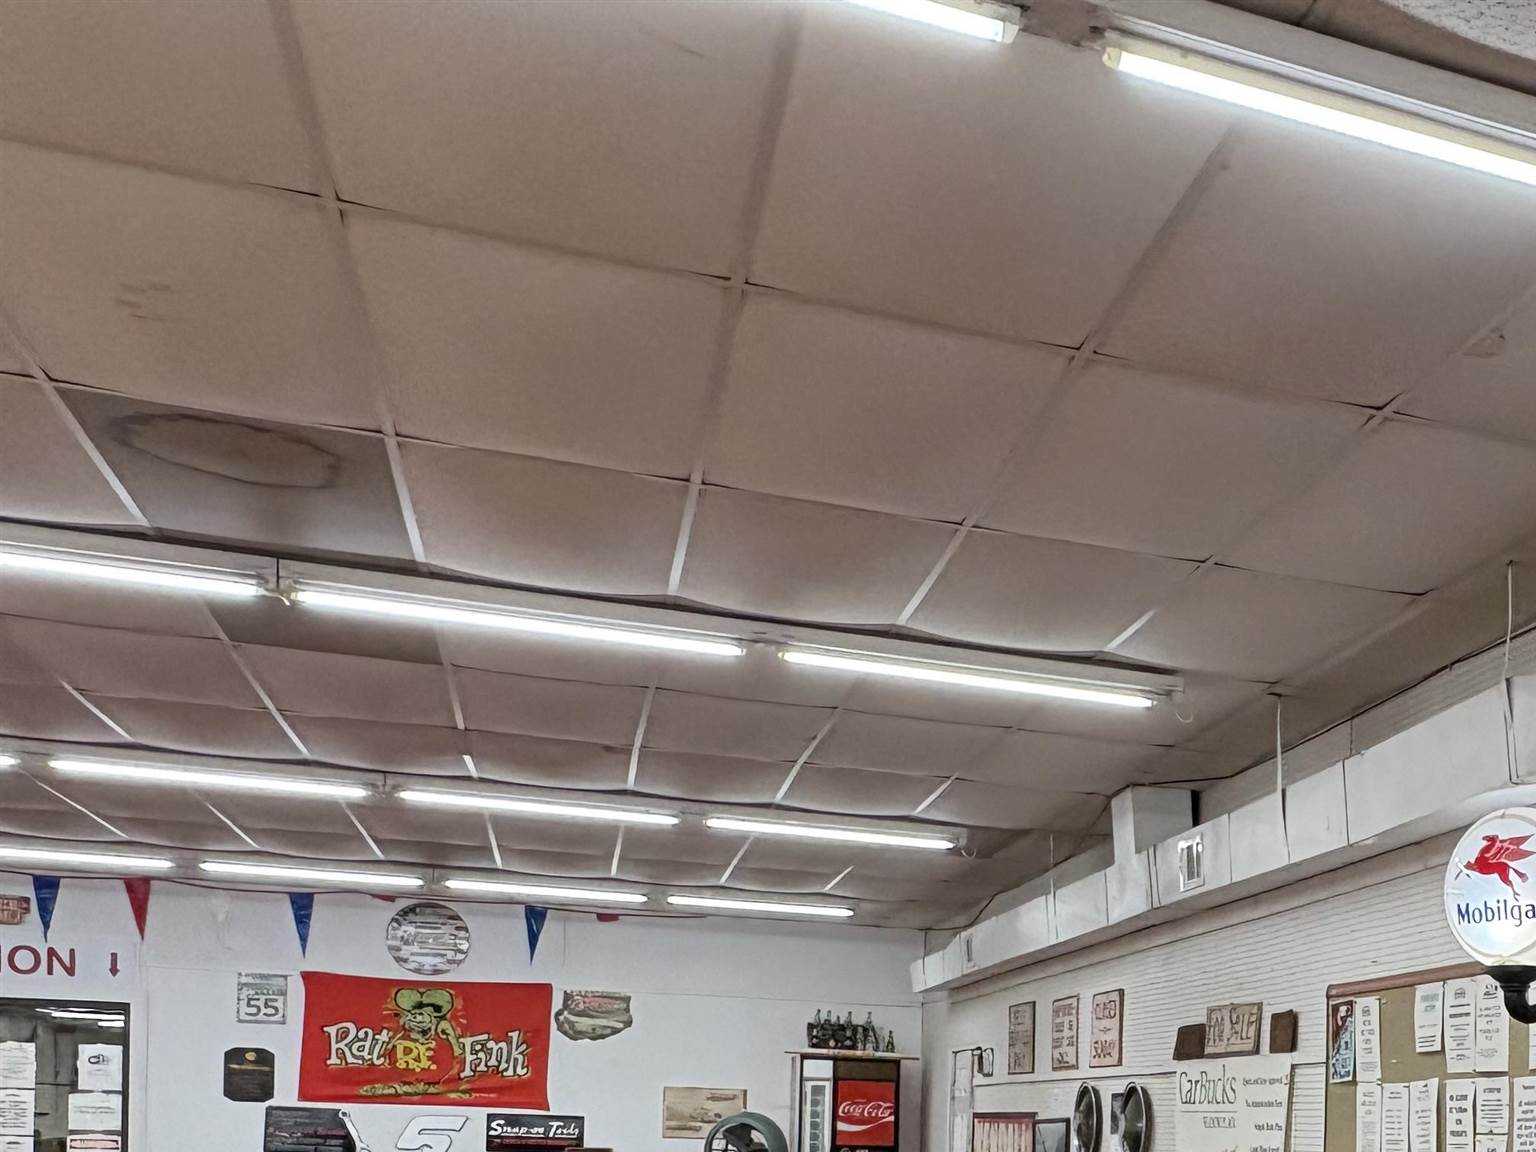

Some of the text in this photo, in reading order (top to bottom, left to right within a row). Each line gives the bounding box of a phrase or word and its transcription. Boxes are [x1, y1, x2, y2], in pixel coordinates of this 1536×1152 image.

[244, 997, 280, 1018] 55
[323, 1021, 529, 1080] Rat Fink
[1179, 1063, 1237, 1105] CarBucks
